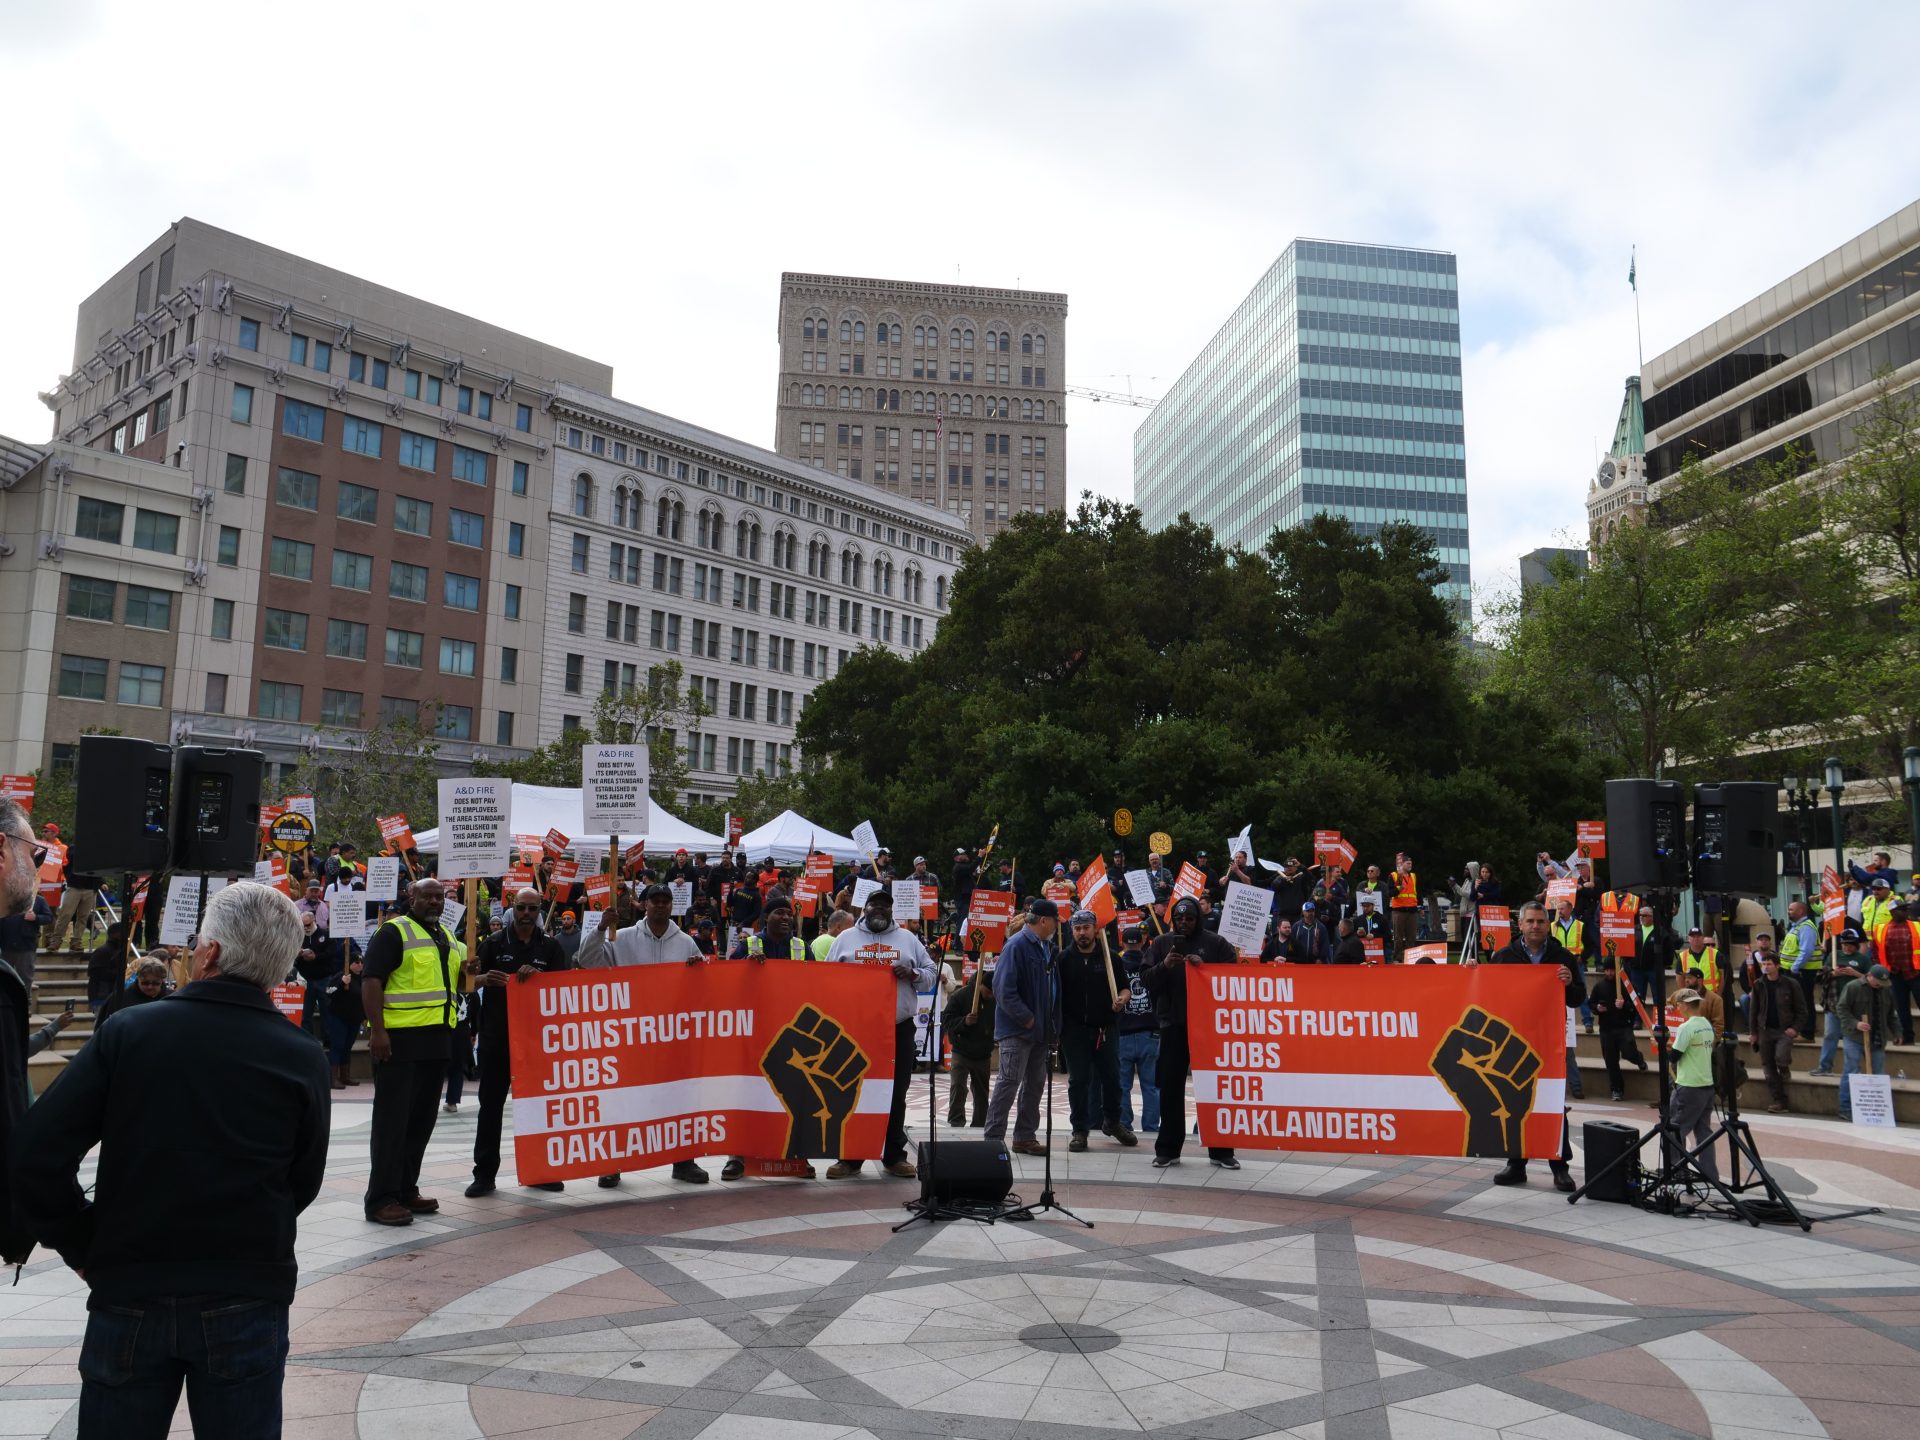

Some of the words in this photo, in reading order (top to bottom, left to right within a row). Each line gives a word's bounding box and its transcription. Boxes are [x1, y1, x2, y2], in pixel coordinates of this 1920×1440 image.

[455, 787, 474, 795] A&D
[857, 951, 898, 959] HARLEY-DAVIDSON
[1408, 950, 1442, 959] CONSTRUCTION
[539, 982, 630, 1016] UNION
[1212, 976, 1294, 1003] UNION
[542, 1009, 754, 1054] CONSTRUCTION
[1215, 1008, 1418, 1038] CONSTRUCTION
[1215, 1041, 1280, 1069] JOBS
[543, 1055, 619, 1091] JOBS
[1217, 1074, 1263, 1102] FOR
[546, 1094, 601, 1128] FOR
[1216, 1108, 1397, 1142] OAKLANDERS
[547, 1114, 726, 1167] OAKLANDERS
